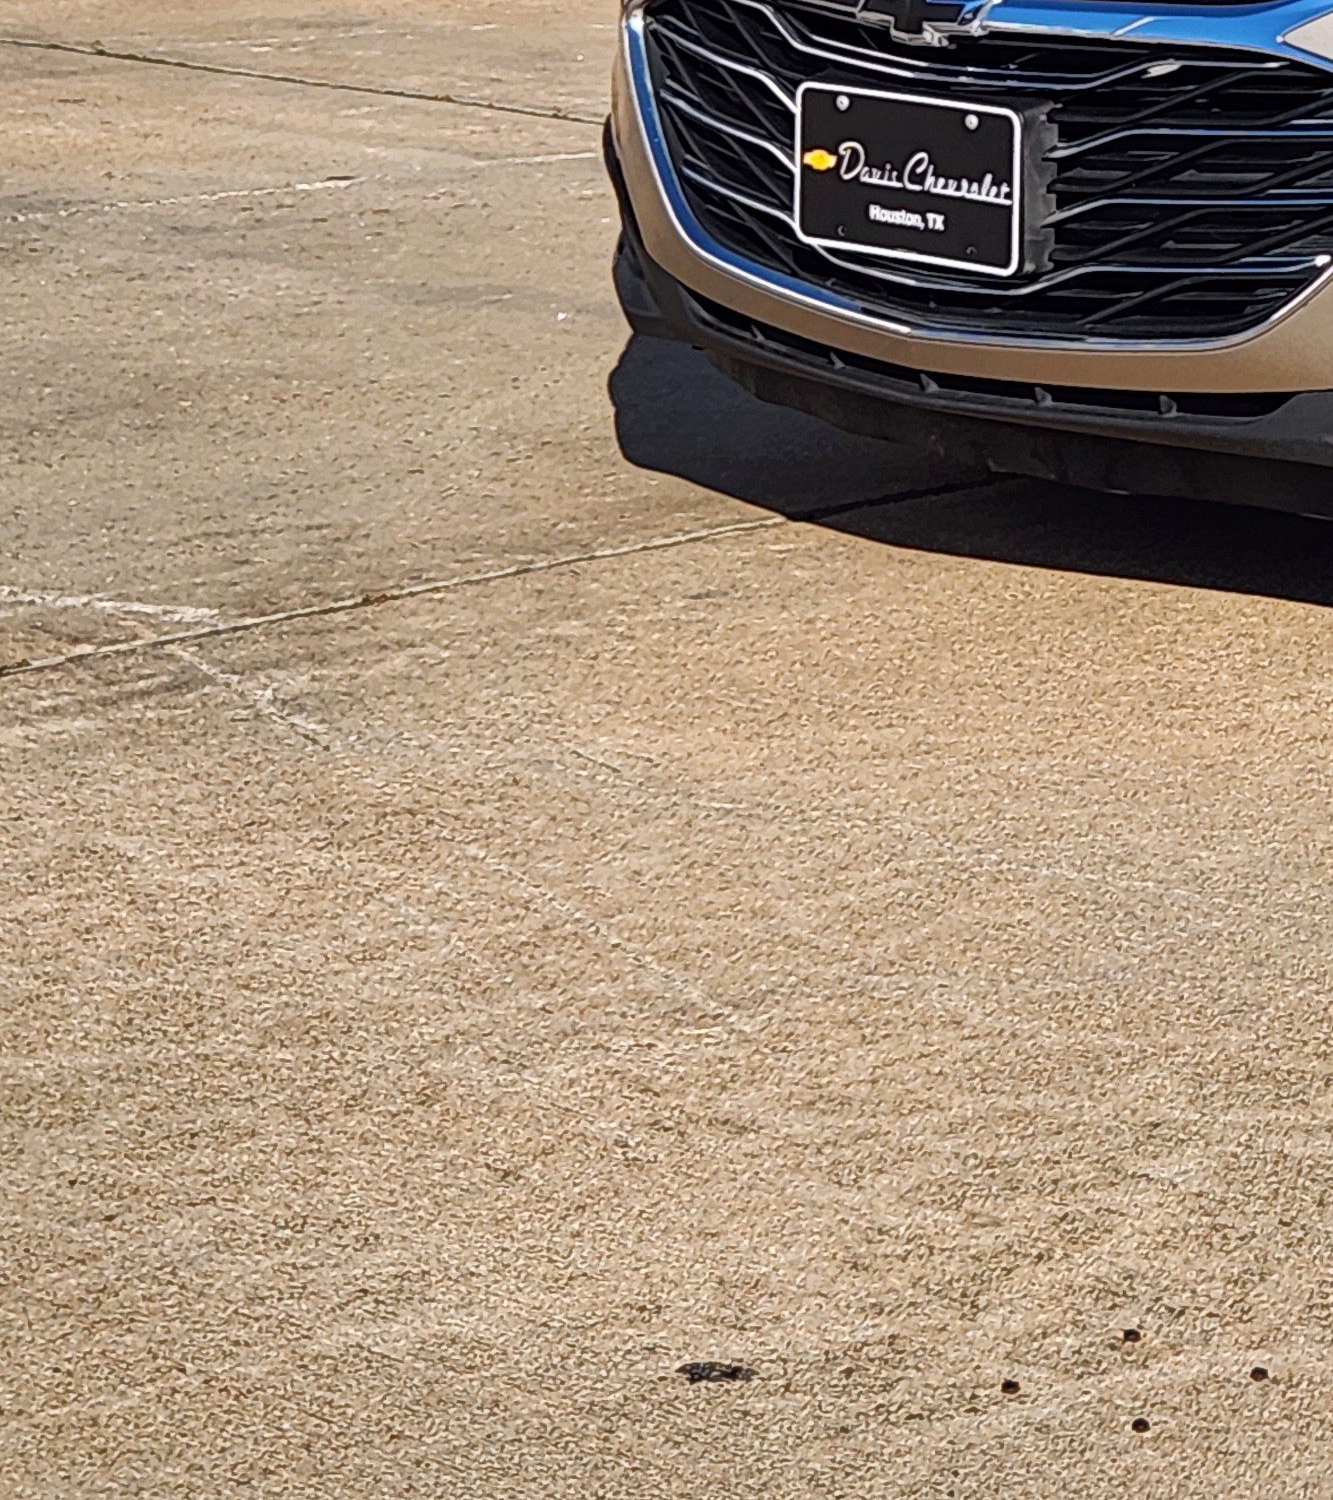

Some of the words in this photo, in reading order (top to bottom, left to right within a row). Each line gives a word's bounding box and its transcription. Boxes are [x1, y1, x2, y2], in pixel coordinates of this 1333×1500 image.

[838, 141, 905, 188] Davis
[903, 151, 1013, 206] Chevrolet
[868, 203, 925, 231] Houston,
[925, 212, 945, 231] TX
